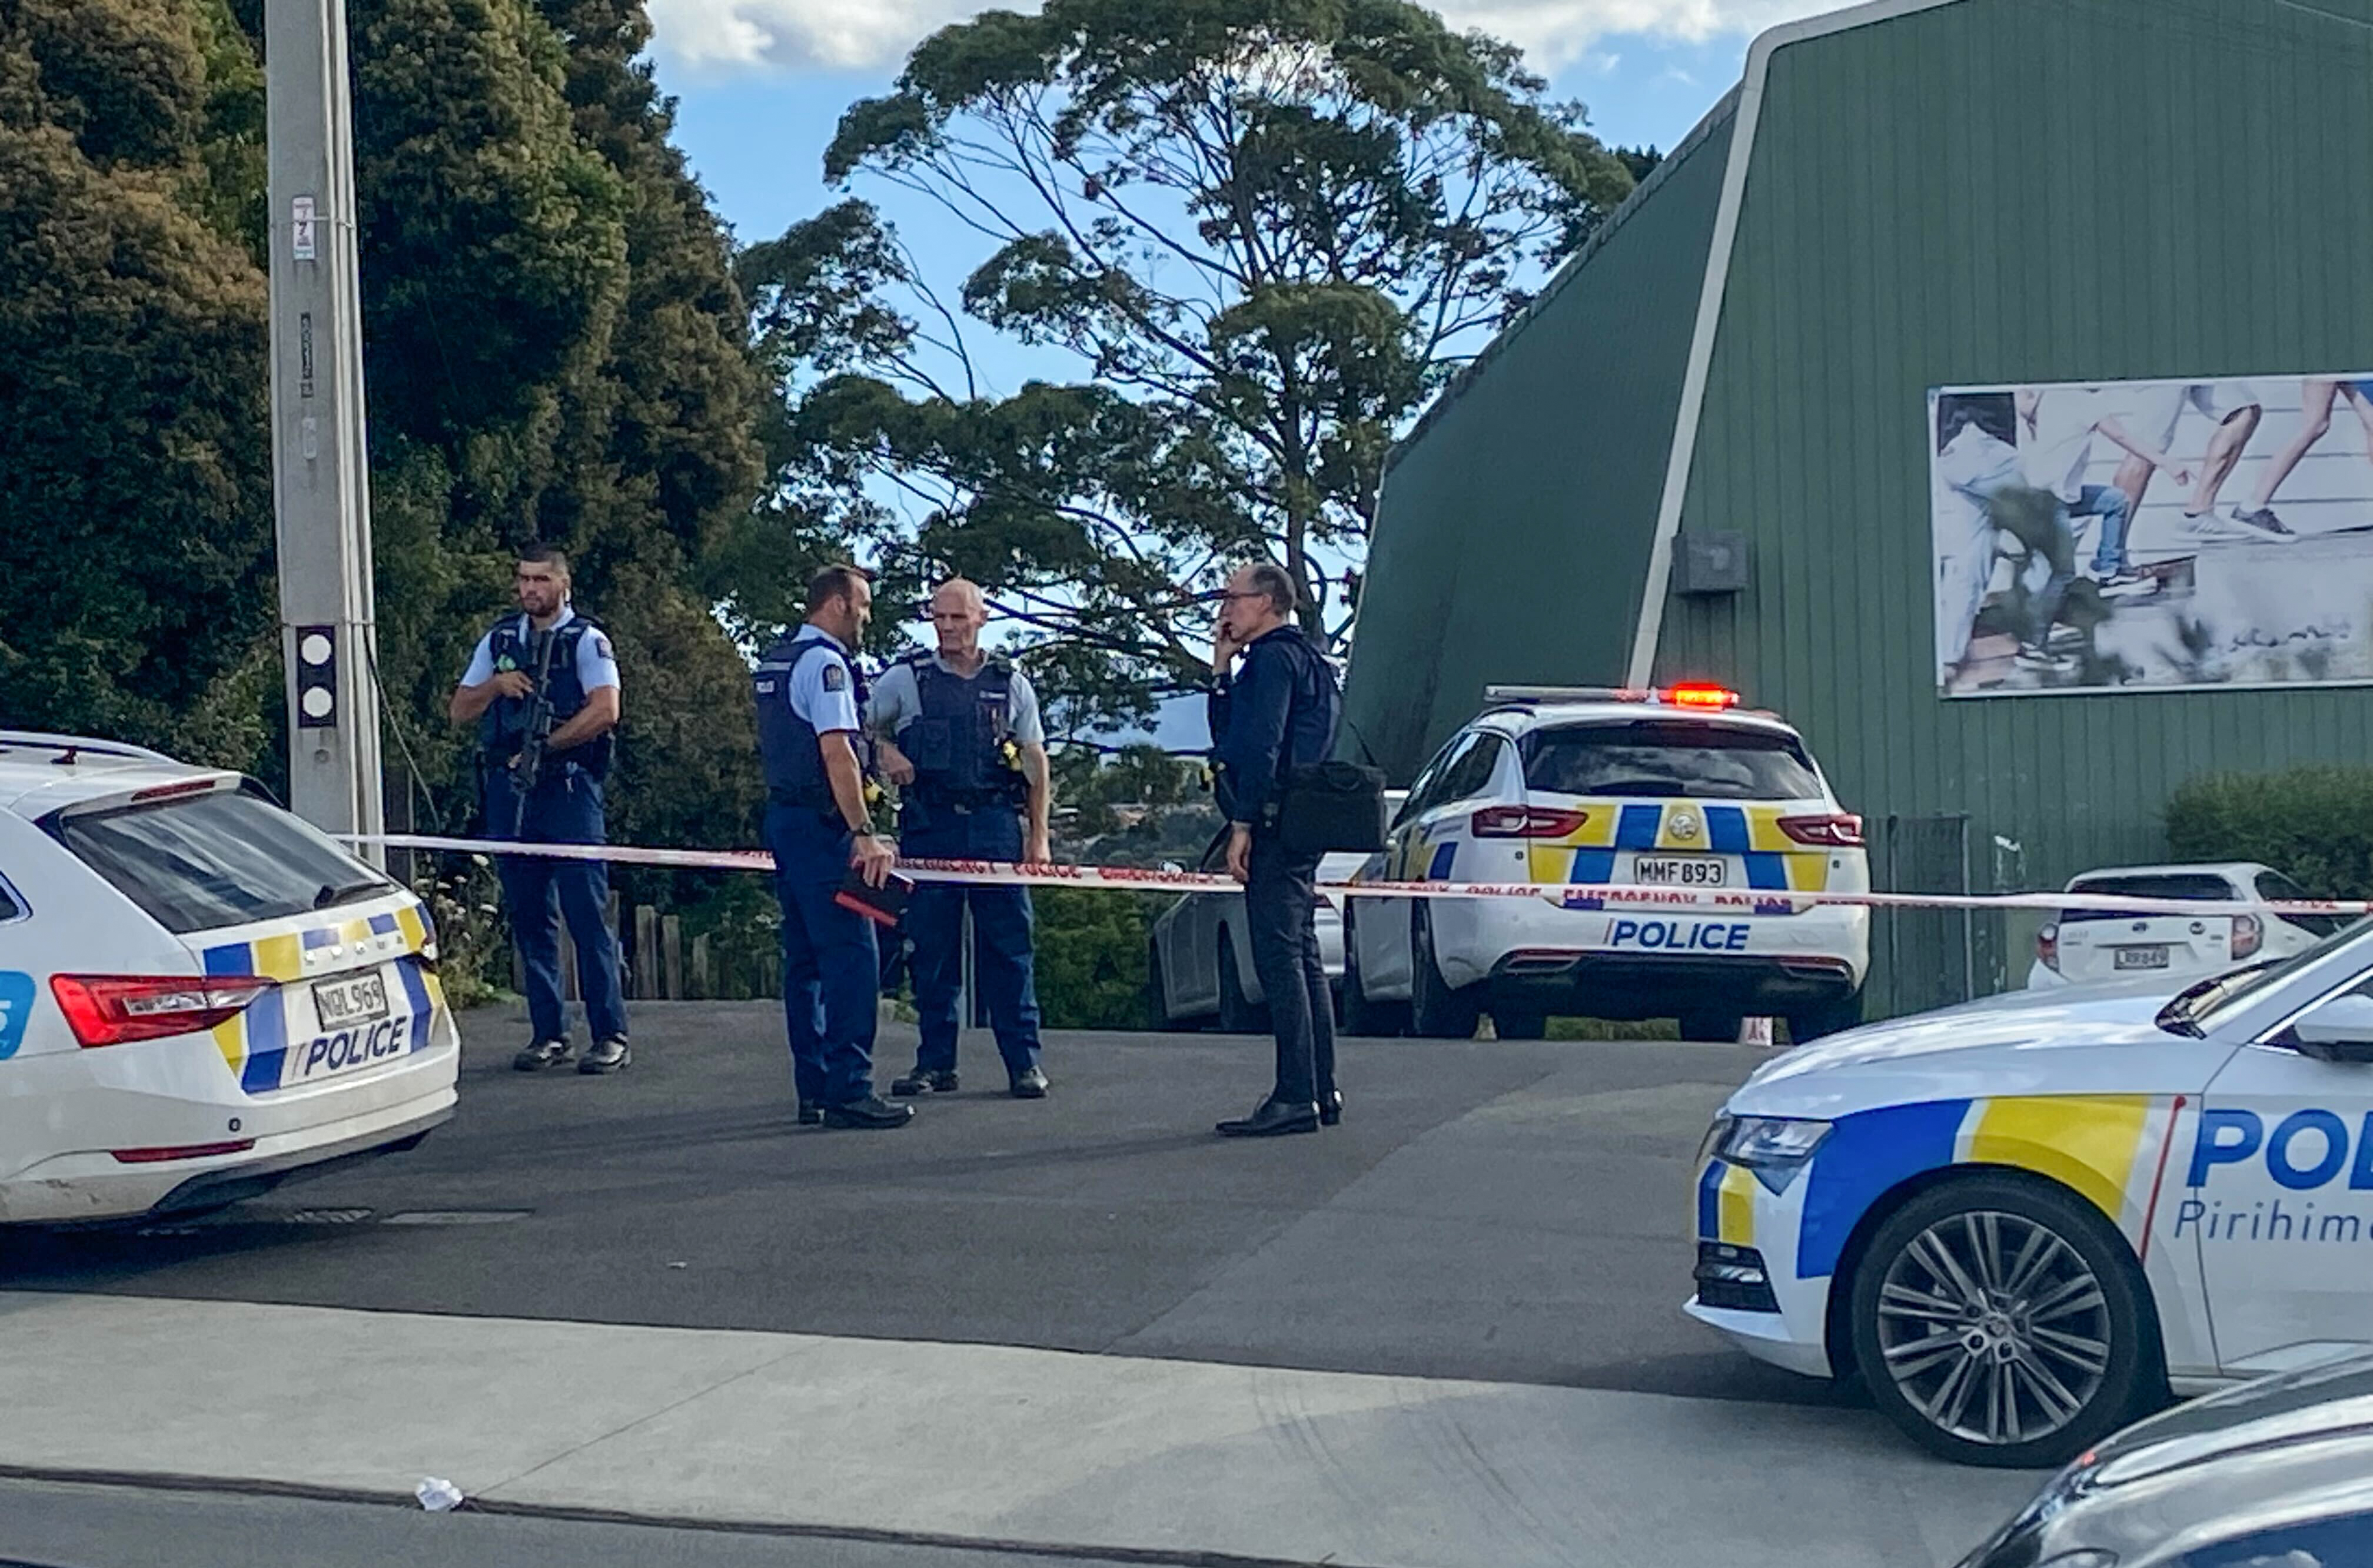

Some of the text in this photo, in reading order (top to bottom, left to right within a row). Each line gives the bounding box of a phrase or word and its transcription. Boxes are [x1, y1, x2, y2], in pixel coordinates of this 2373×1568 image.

[1639, 861, 1722, 883] MMF893
[1611, 920, 1751, 951] POLICE
[304, 1015, 407, 1076] POLICE
[2174, 1198, 2373, 1242] Pirihim
